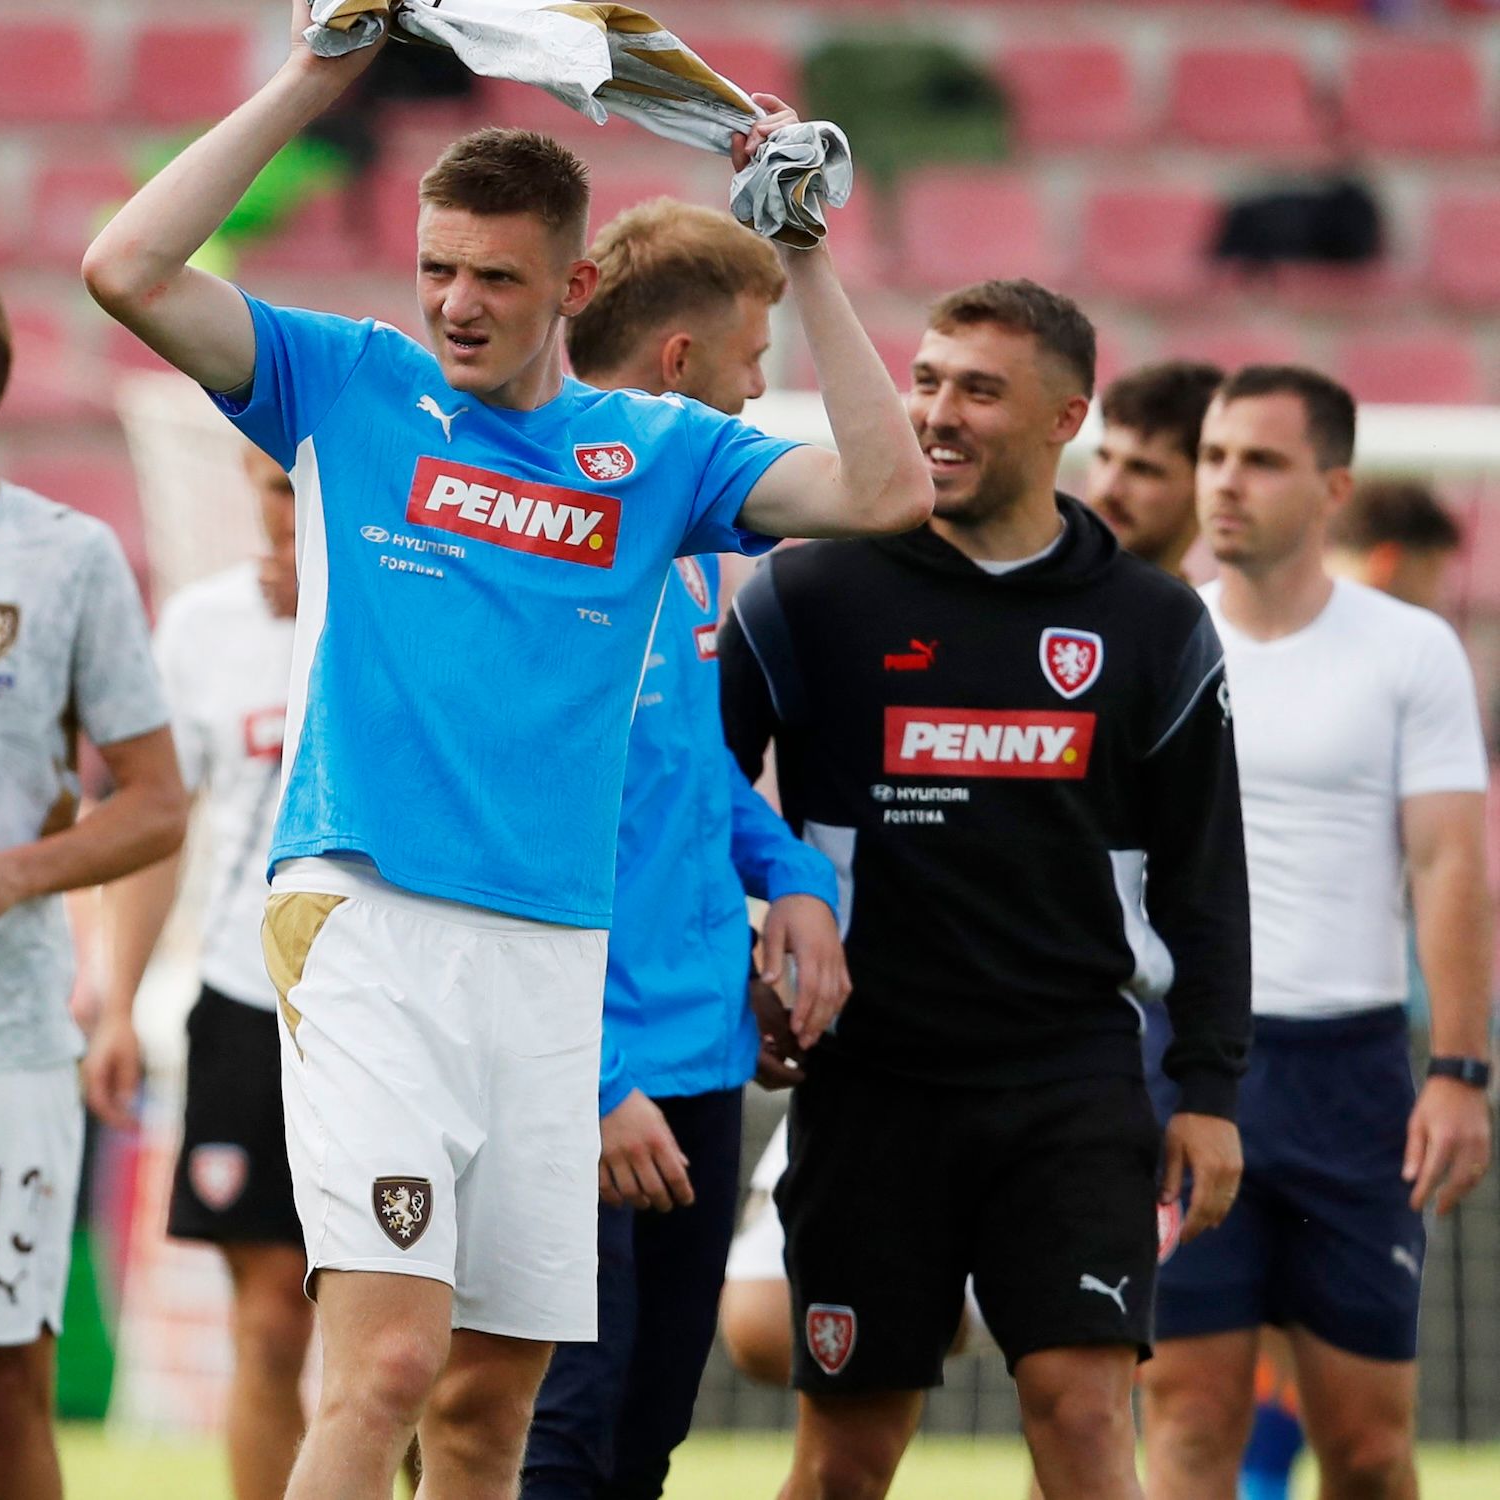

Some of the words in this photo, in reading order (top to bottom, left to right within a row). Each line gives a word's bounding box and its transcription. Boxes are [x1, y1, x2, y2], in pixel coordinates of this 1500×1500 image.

[393, 533, 466, 559] HYUNDAI
[379, 555, 445, 580] FORTUNA
[576, 607, 613, 627] TCL
[896, 787, 970, 802] HYUNDAI
[883, 809, 946, 824] FORTUNA
